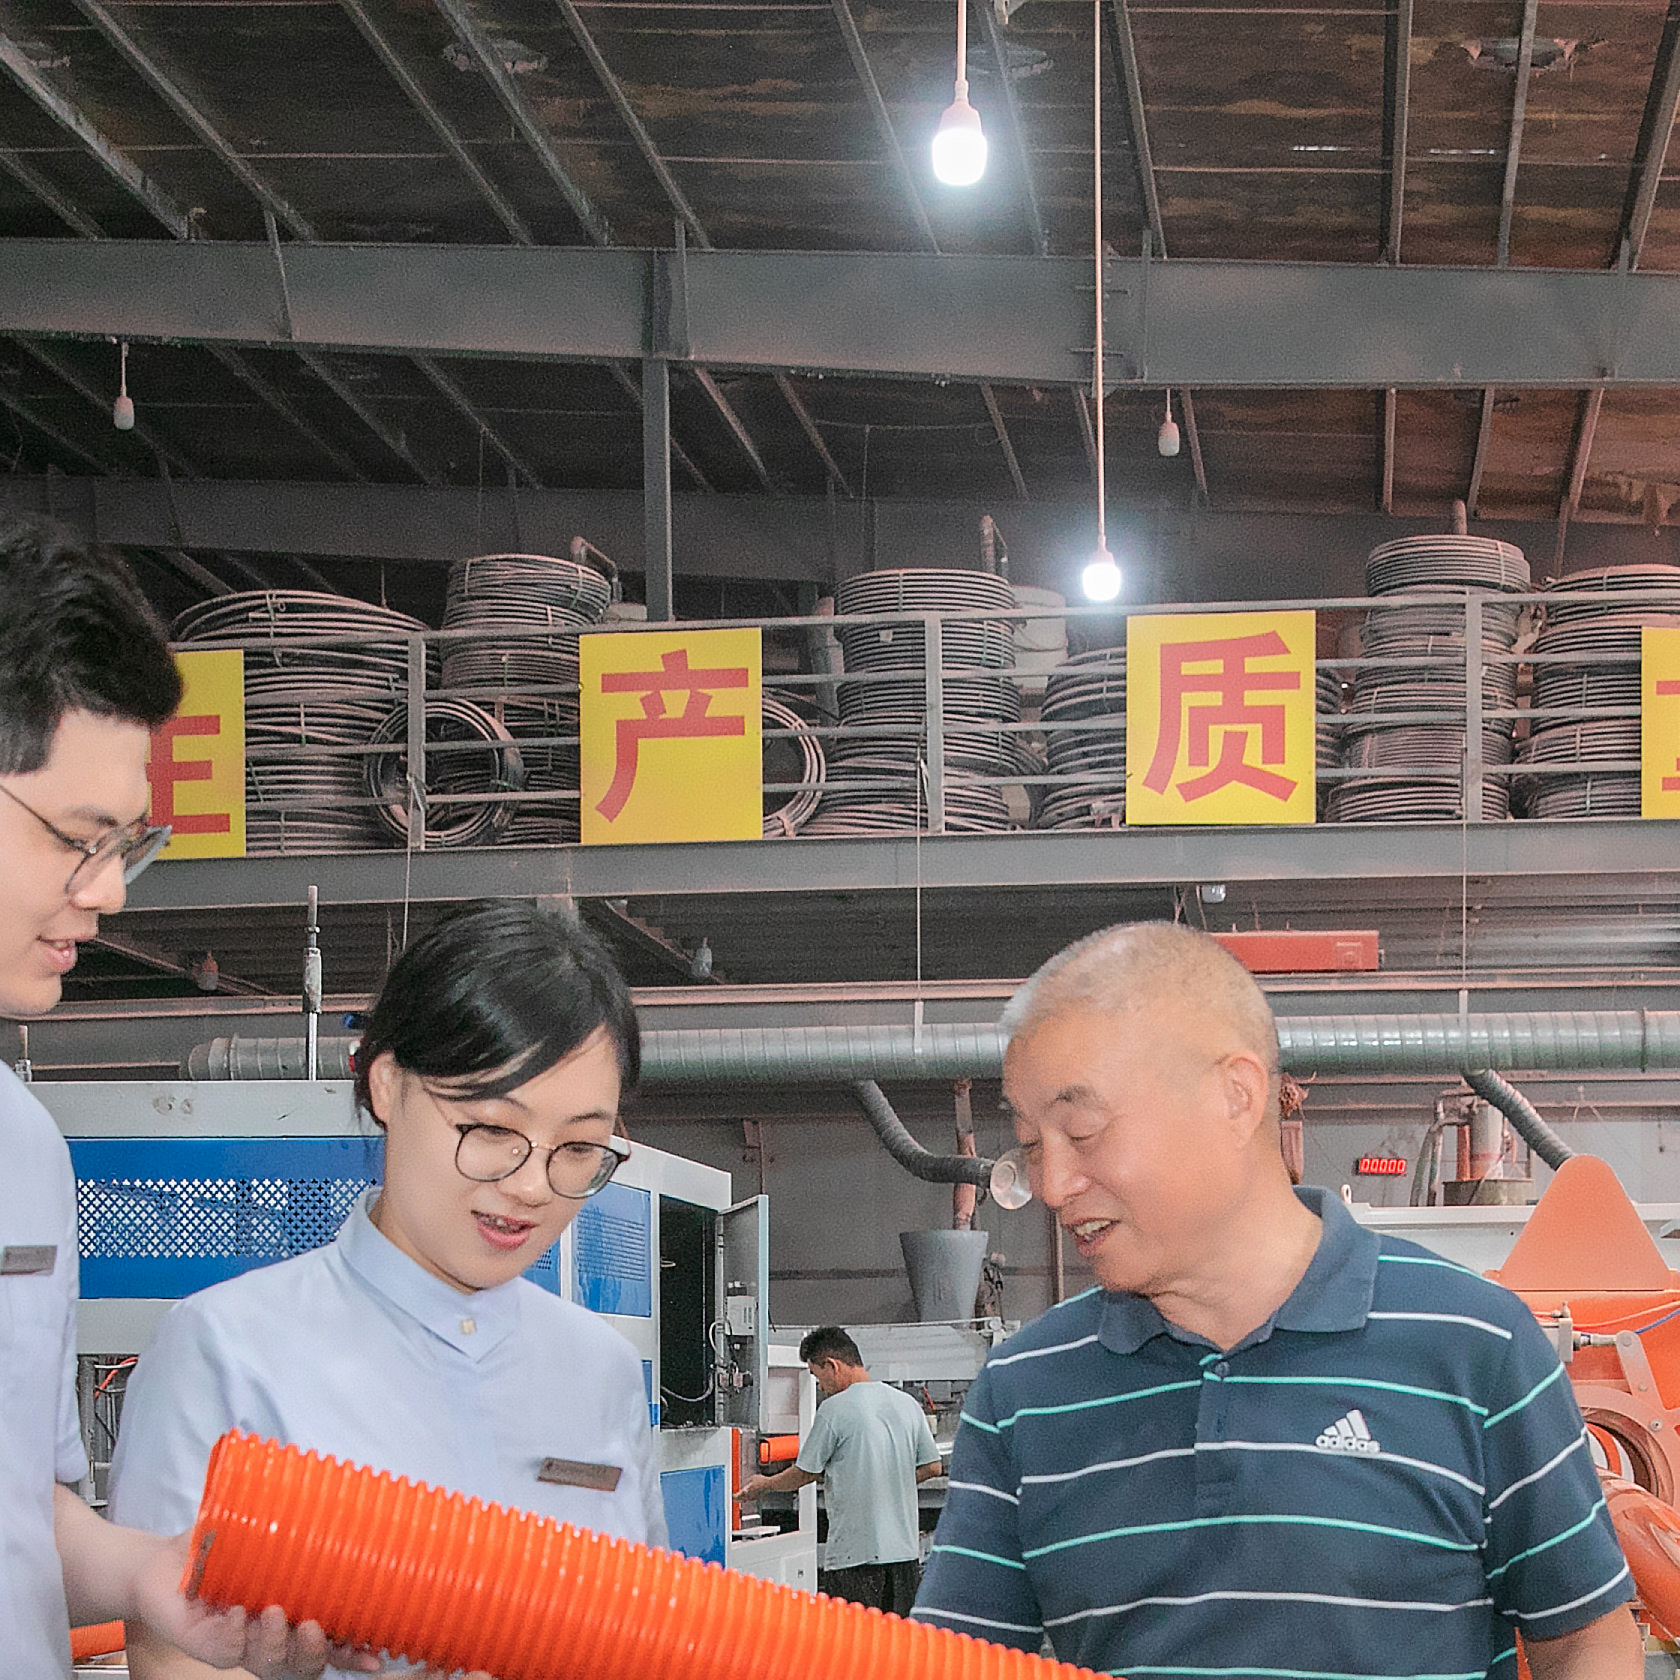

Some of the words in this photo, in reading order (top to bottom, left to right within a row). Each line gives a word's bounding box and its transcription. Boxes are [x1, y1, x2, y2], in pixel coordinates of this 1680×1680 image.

[596, 649, 749, 821] 产
[1142, 630, 1302, 803] 质
[1316, 1435, 1380, 1454] adidas
